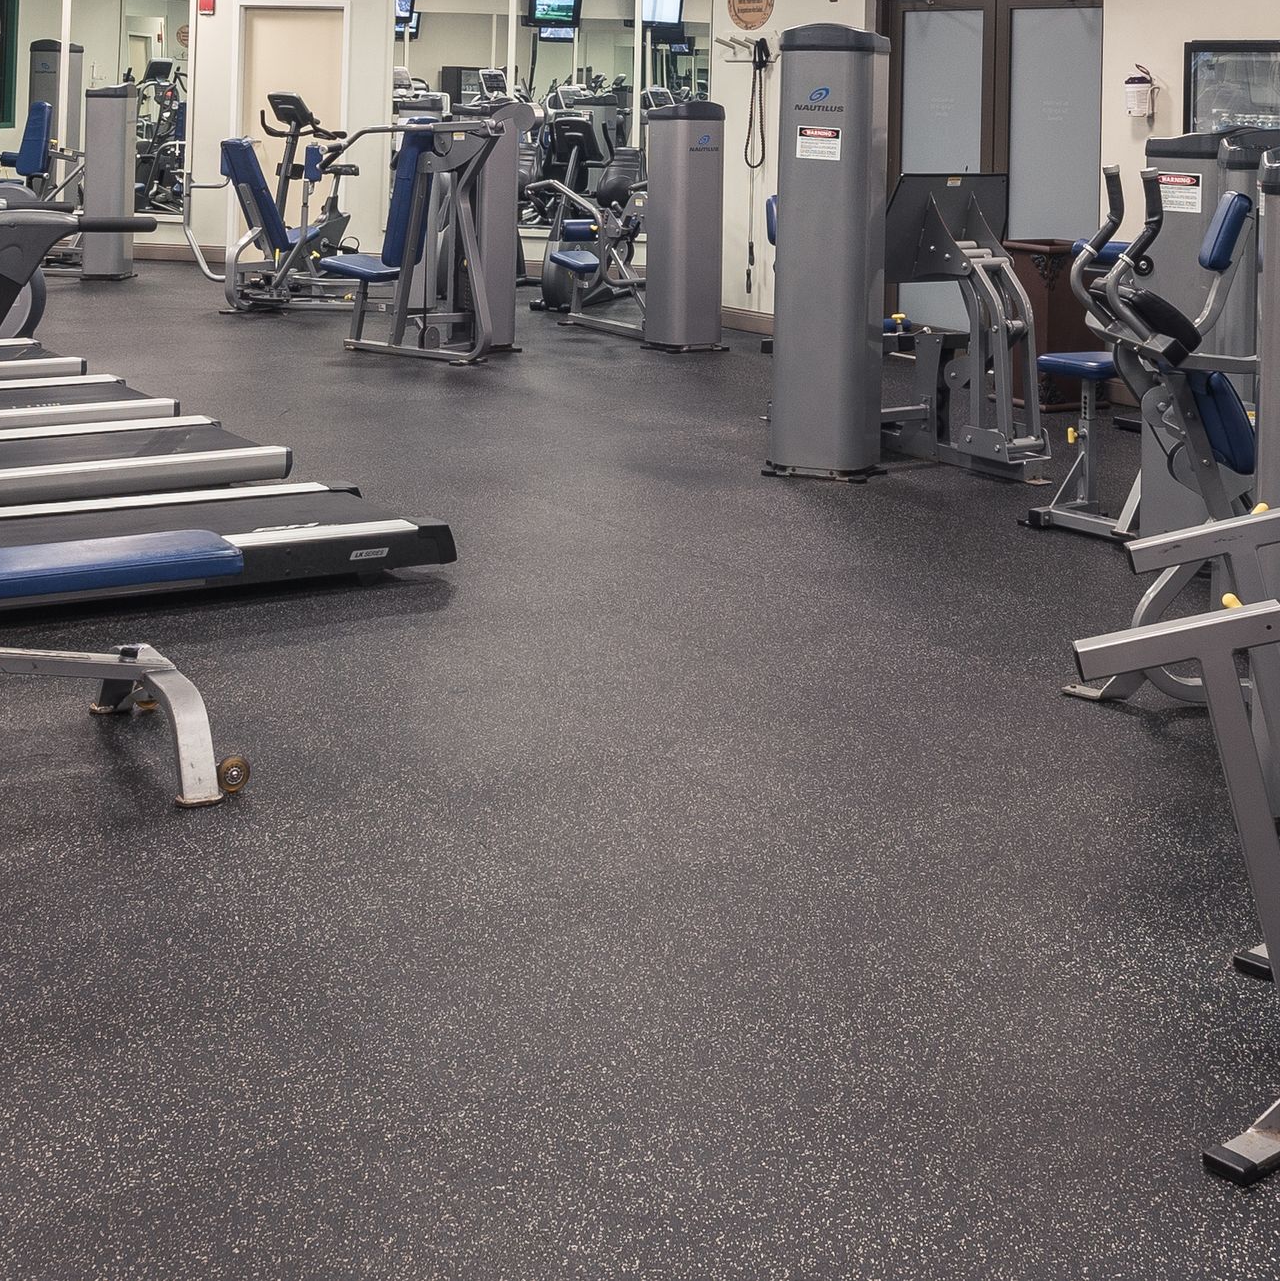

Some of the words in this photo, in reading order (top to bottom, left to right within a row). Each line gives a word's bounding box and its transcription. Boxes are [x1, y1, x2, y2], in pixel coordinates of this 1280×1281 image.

[794, 104, 844, 113] NAUTILUS
[806, 129, 832, 137] WARNING
[364, 549, 385, 557] SERIES
